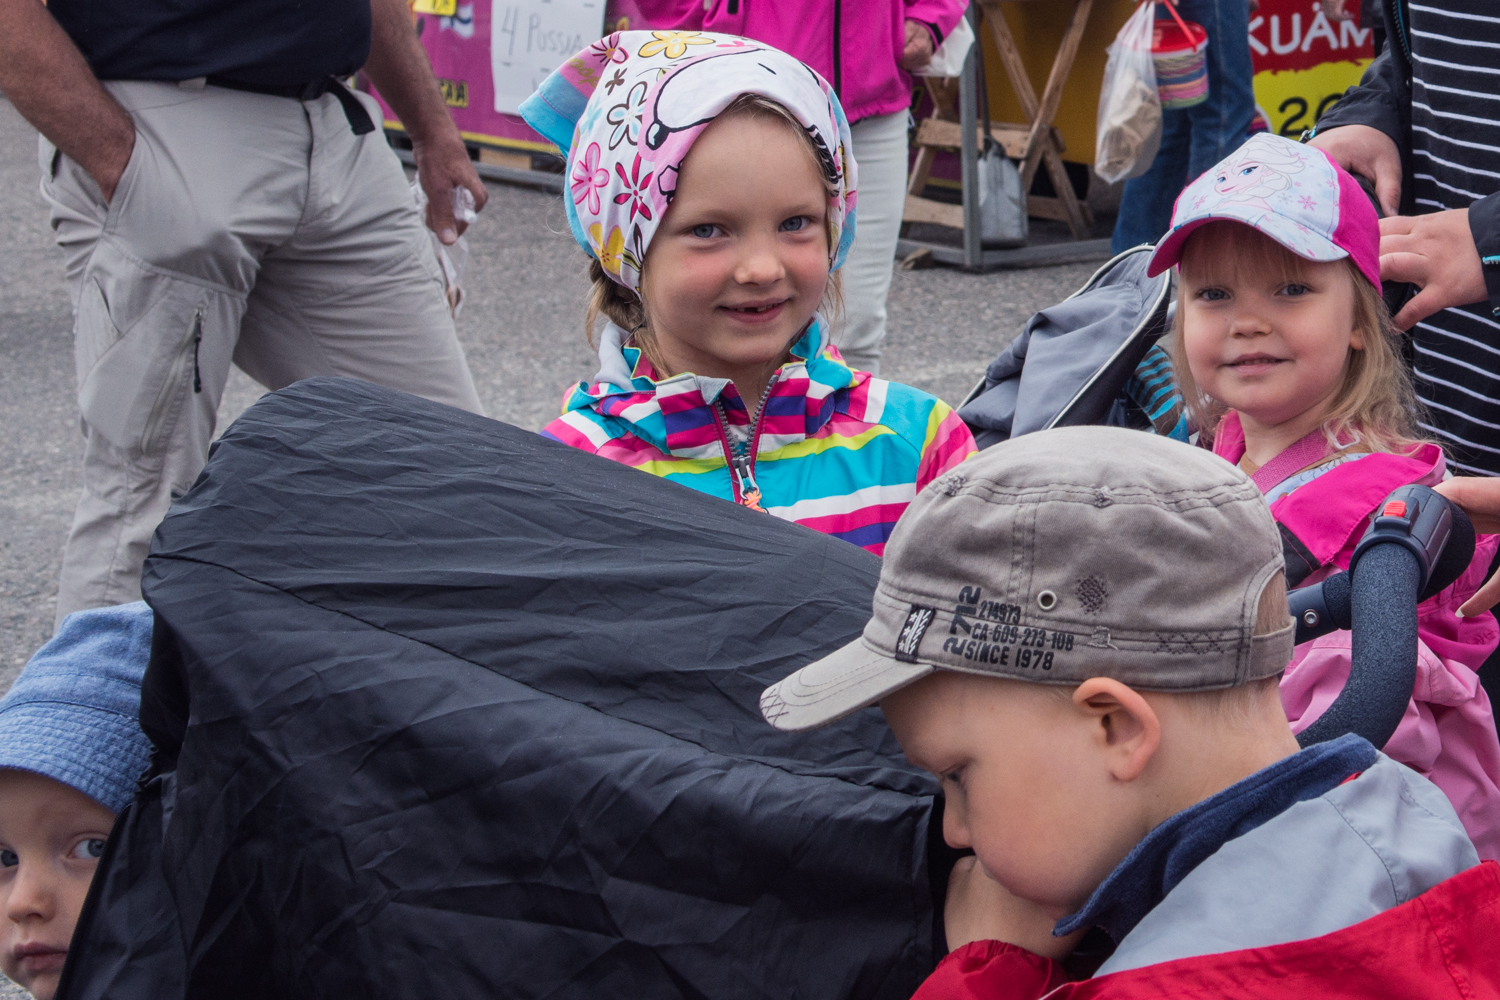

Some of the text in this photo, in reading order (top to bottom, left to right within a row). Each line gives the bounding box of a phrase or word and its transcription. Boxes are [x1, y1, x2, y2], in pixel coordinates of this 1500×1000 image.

[500, 4, 520, 57] 4
[964, 640, 1055, 671] SINCE 1978
